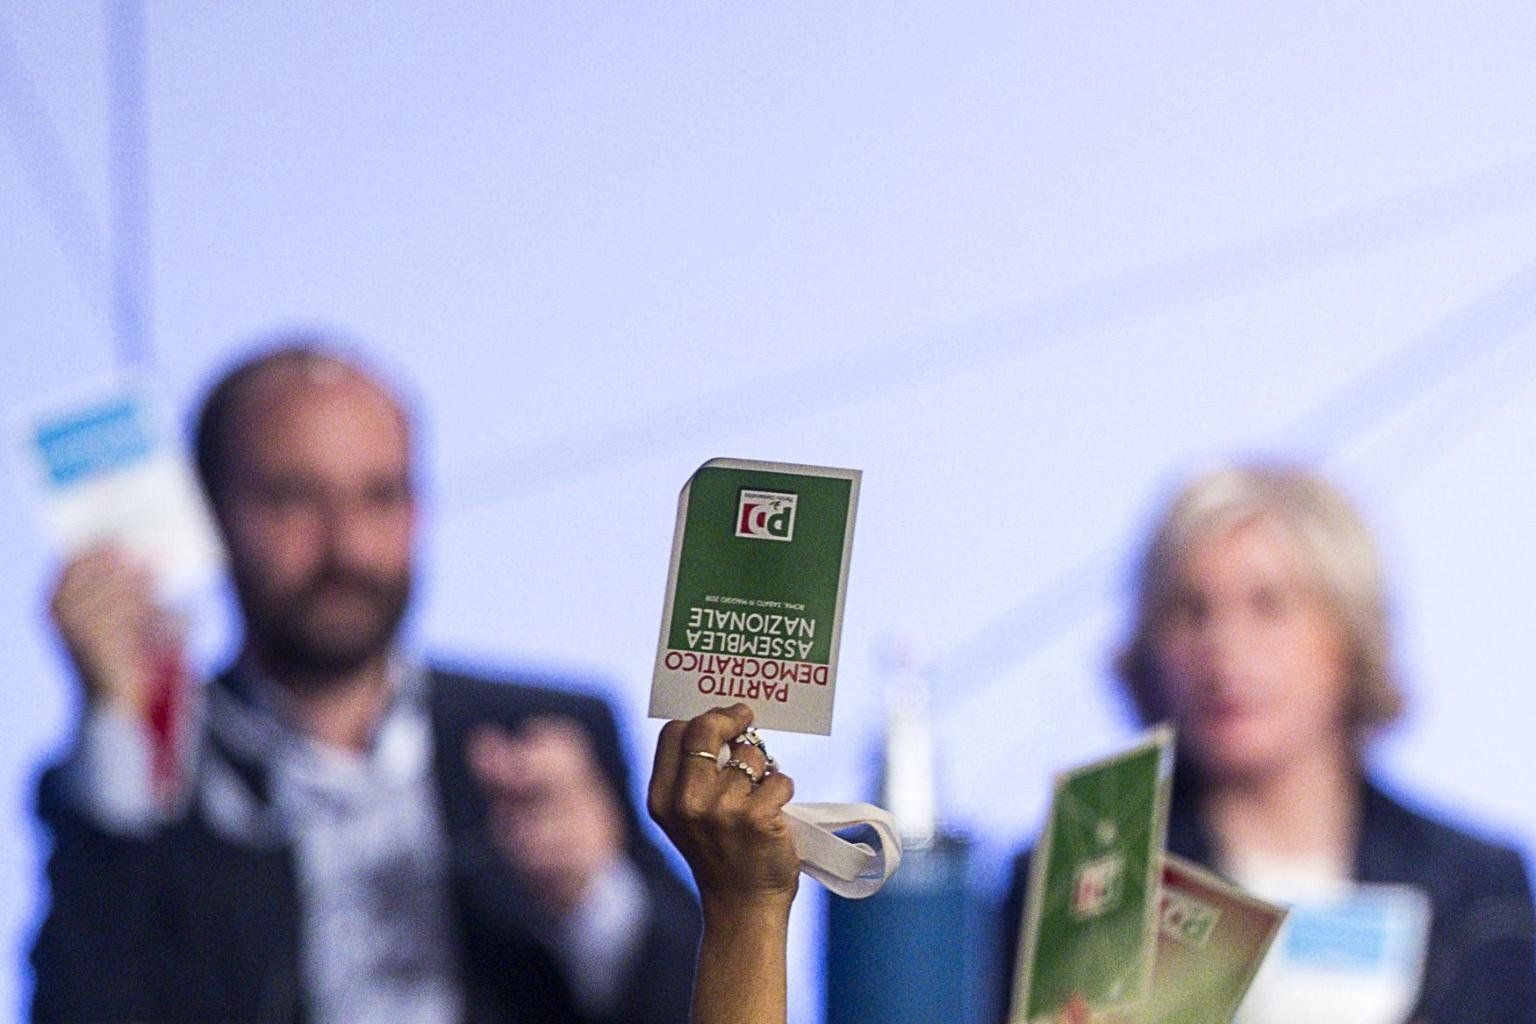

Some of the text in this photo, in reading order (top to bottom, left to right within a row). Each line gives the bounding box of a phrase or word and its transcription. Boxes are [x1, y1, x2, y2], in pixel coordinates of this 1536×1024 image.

[740, 503, 792, 537] PD
[688, 607, 815, 638] NAZIONALE
[687, 629, 813, 659] ASSEMBLEA
[665, 651, 829, 685] DEMOCRATICO
[698, 675, 788, 702] PARTITO
